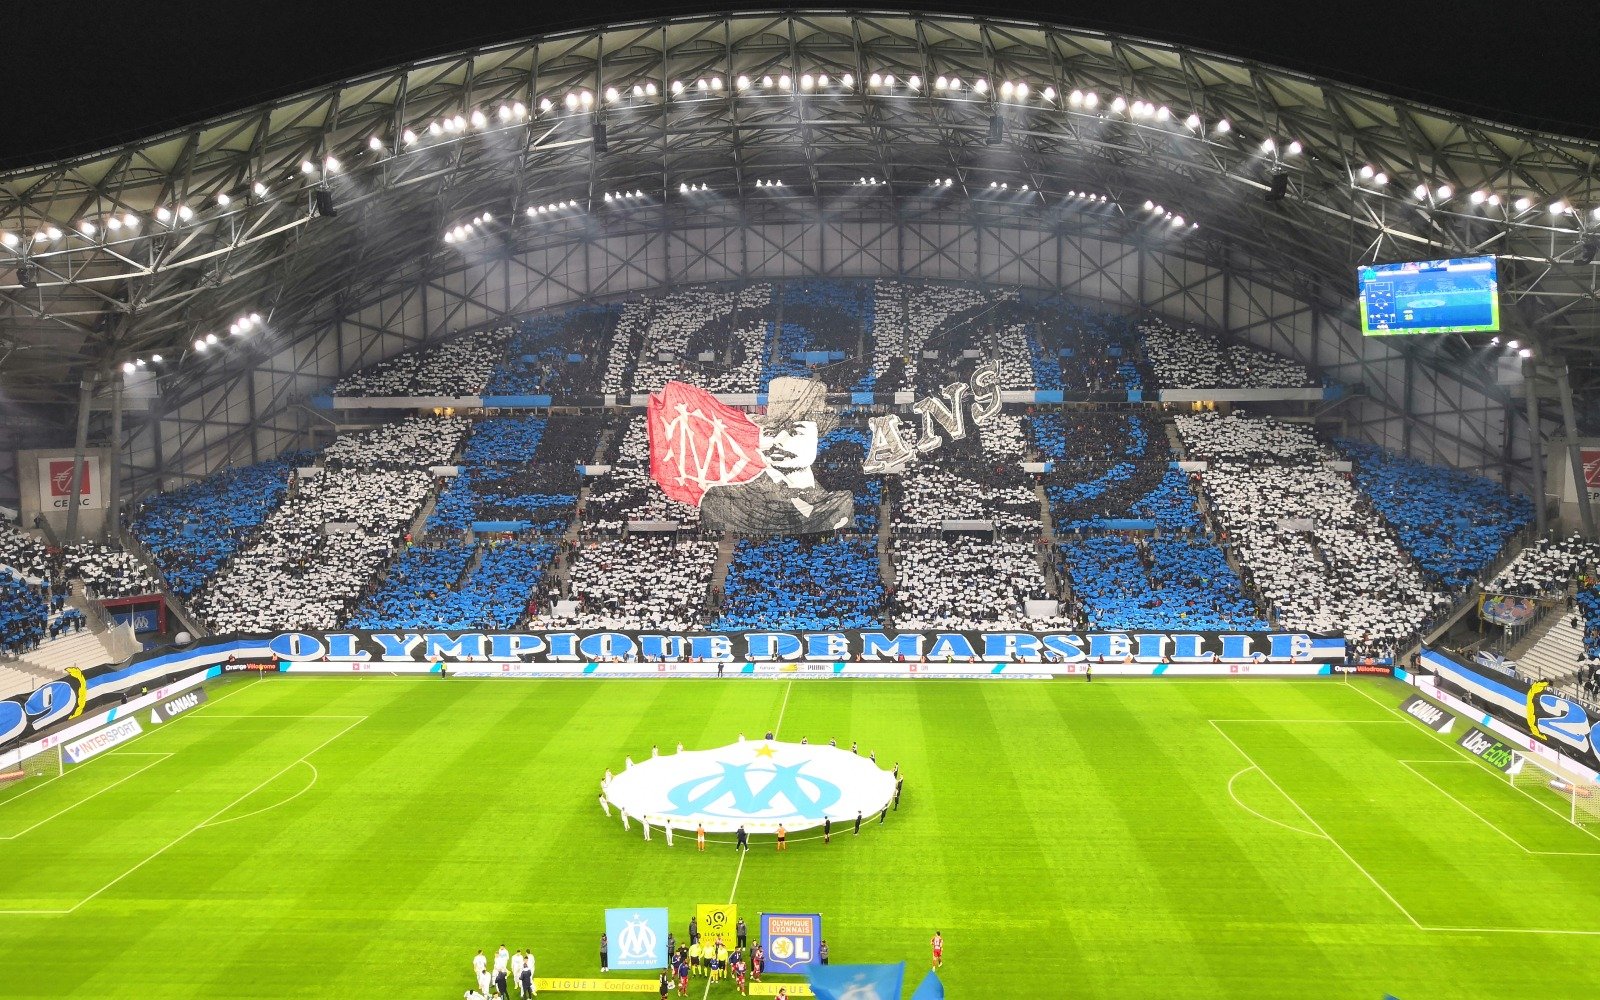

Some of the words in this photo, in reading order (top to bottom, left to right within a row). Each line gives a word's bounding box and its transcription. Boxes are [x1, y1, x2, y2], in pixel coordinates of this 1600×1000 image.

[862, 358, 1002, 474] ANS
[53, 499, 90, 508] CEC
[268, 632, 734, 663] OLYMPIQUE
[744, 632, 851, 662] DE
[859, 632, 1314, 664] MARSEILLE
[1334, 665, 1357, 673] Orange
[164, 692, 199, 716] CANAL+
[79, 721, 136, 754] INTERSPORT
[1461, 729, 1492, 755] Uber
[1481, 742, 1512, 768] Eats
[771, 919, 809, 927] OLYMPIQUE
[772, 936, 810, 959] OL
[552, 980, 587, 989] LIGUE
[604, 982, 655, 991] Conforama
